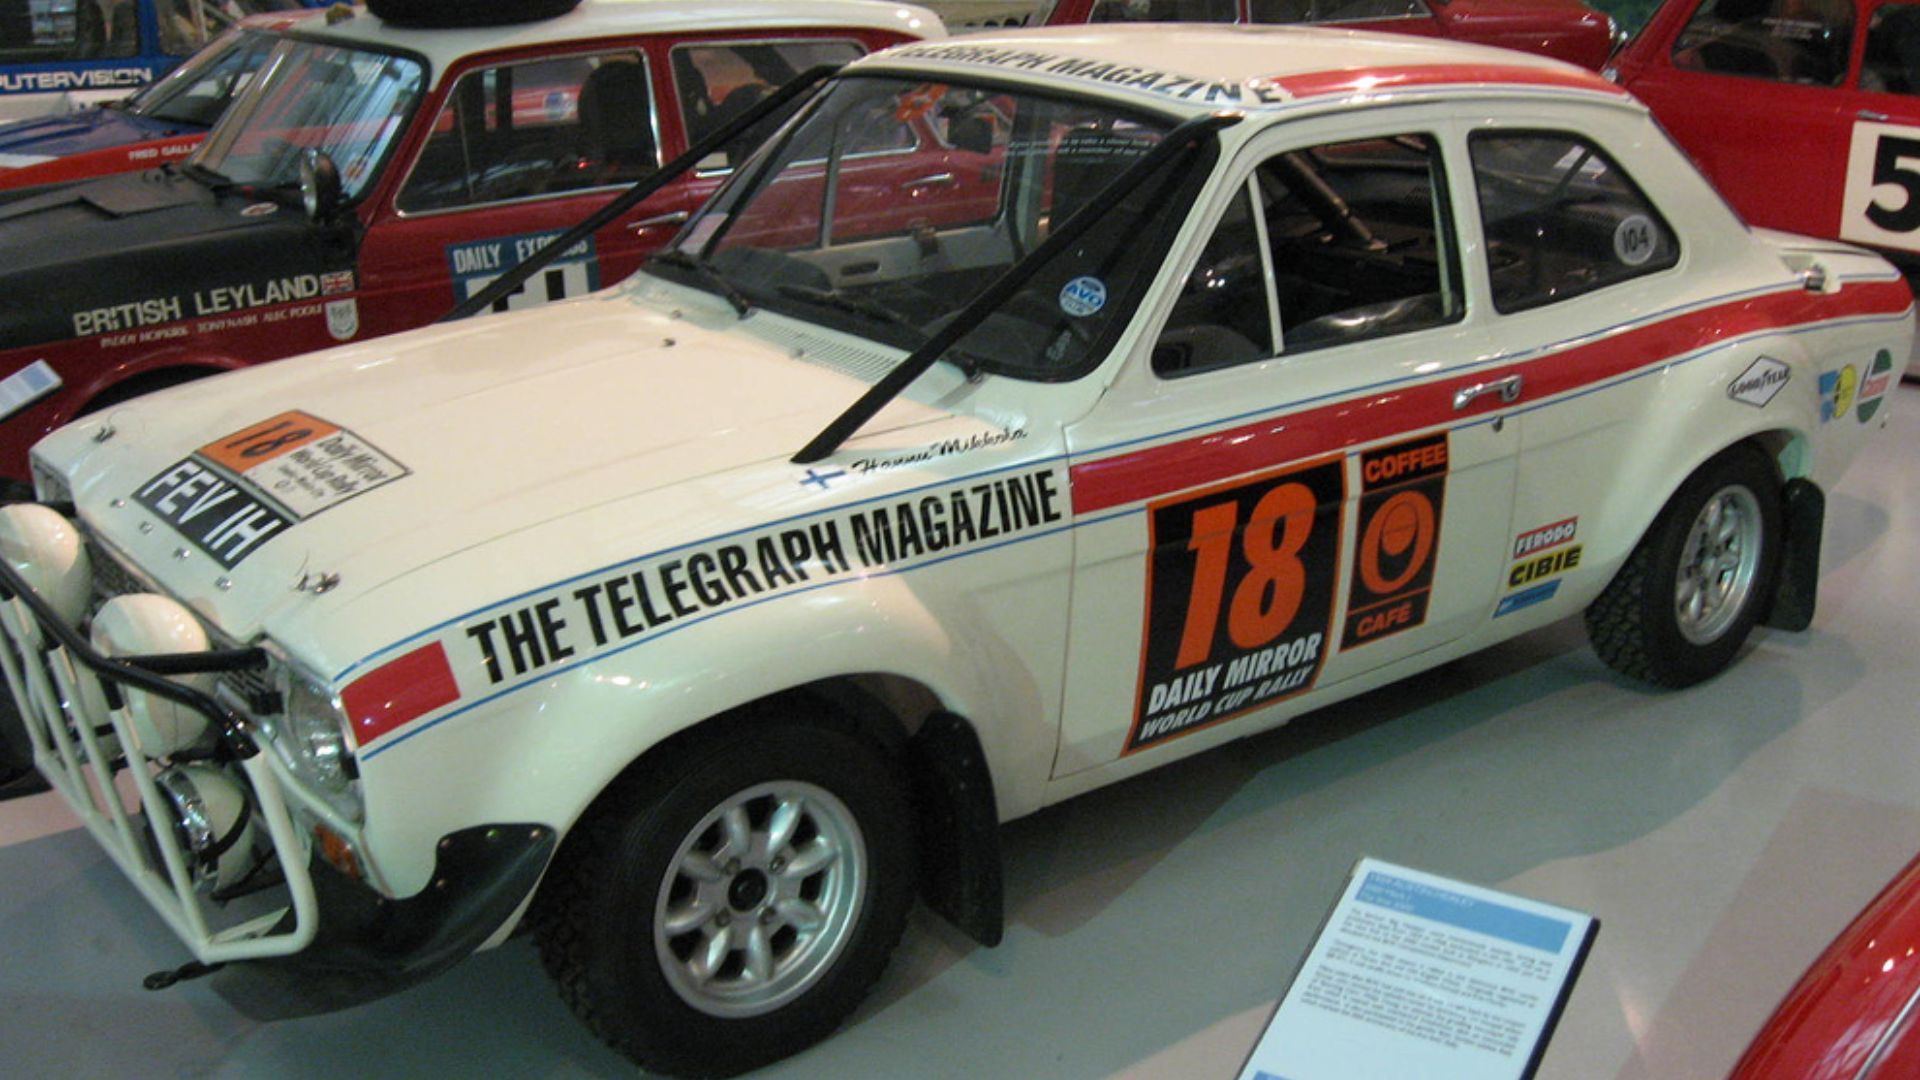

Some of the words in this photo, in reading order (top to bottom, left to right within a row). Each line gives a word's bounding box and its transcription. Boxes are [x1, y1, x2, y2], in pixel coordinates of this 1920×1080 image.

[1047, 54, 1283, 103] MAGAZINE
[1865, 134, 1920, 233] 5
[453, 243, 500, 274] DAILY
[1623, 224, 1649, 255] 104
[73, 296, 181, 337] BRITISH
[194, 274, 319, 315] LEYLAND
[226, 420, 314, 460] 18
[1364, 442, 1448, 484] COFFEE
[141, 460, 240, 525] FEV
[1516, 522, 1576, 554] FERODO
[466, 598, 576, 684] THE
[574, 519, 851, 646] TELEGRAPH
[850, 469, 1062, 568] MAGAZINE
[1174, 481, 1317, 671] 18
[1509, 545, 1582, 588] CIBIE
[1146, 663, 1224, 716] DAILY
[1222, 632, 1323, 690] MIRROR
[1138, 700, 1214, 741] WORLD
[1213, 685, 1255, 715] CUP
[1254, 664, 1315, 701] RALLY
